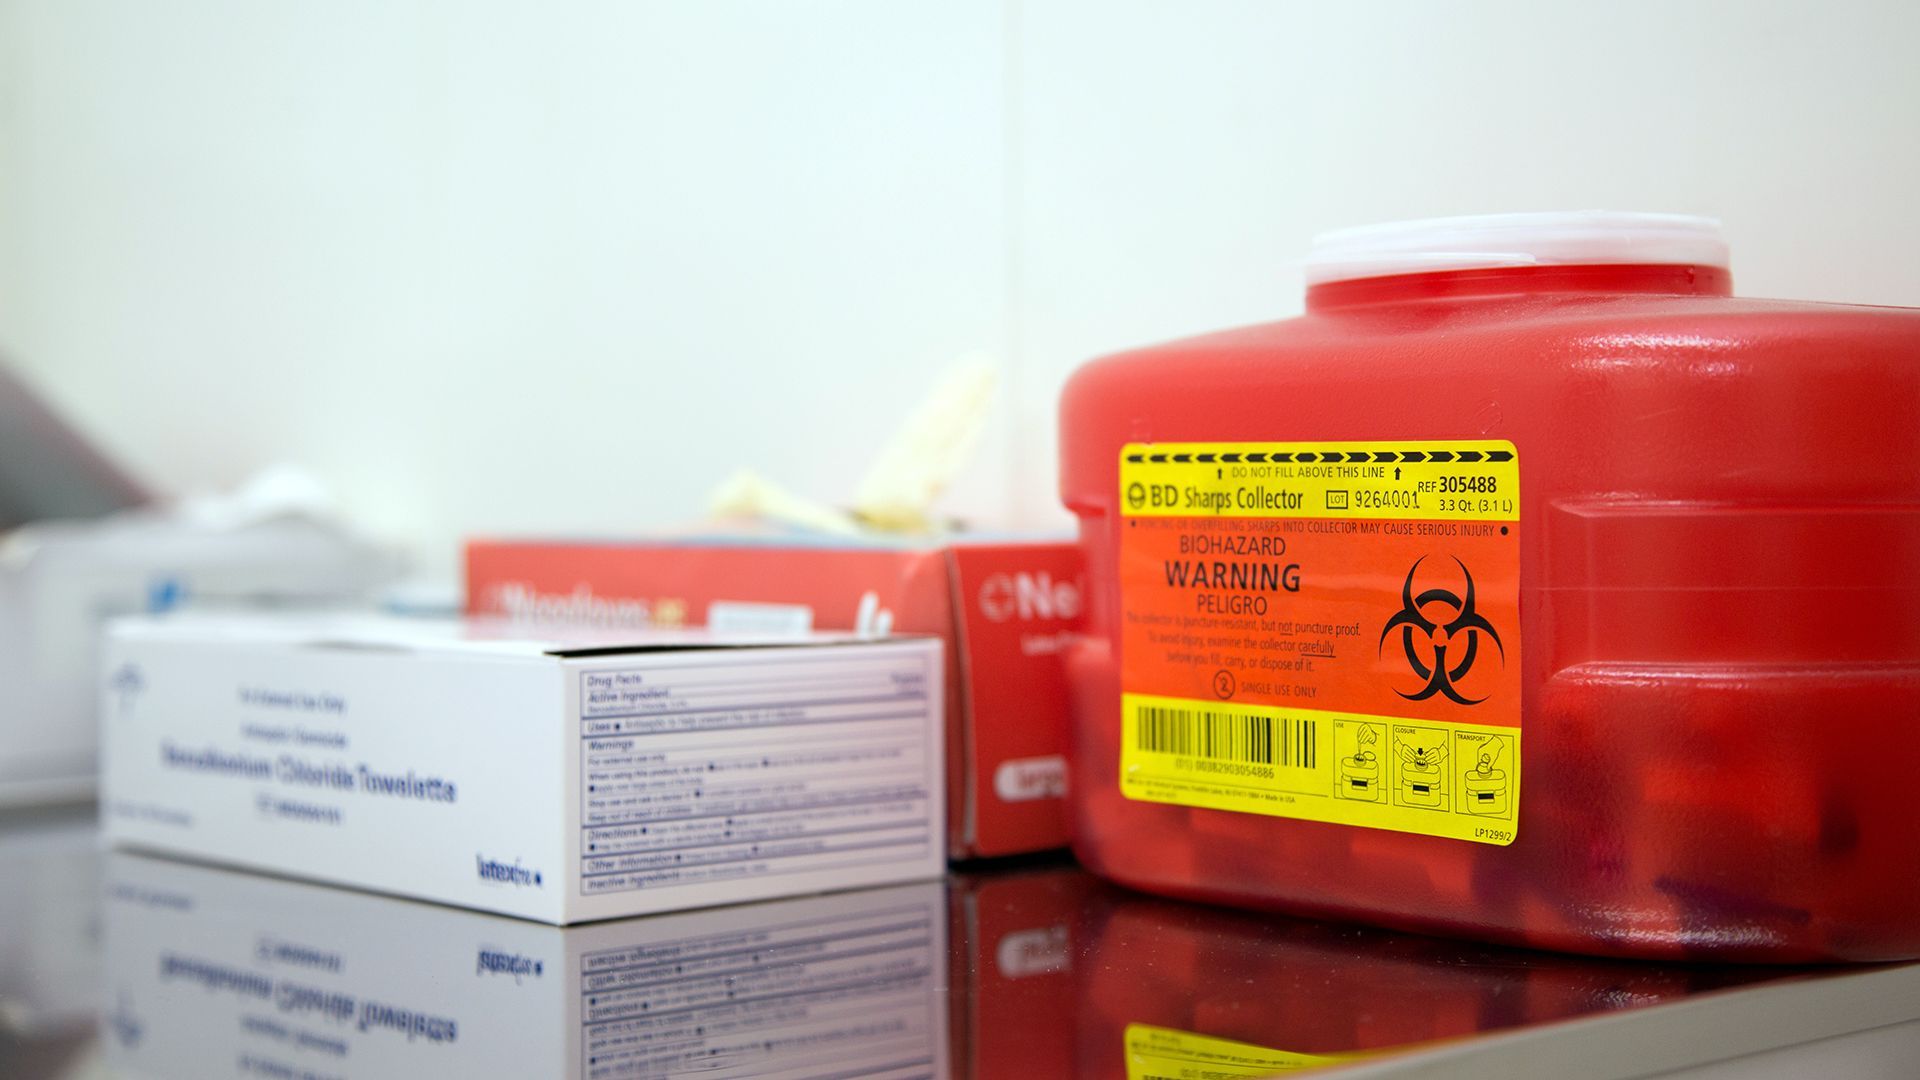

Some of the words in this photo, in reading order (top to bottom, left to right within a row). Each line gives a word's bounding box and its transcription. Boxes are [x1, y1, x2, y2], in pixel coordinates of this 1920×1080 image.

[1232, 466, 1247, 478] DO
[1251, 466, 1271, 478] NOT
[1275, 466, 1294, 478] FILL
[1297, 466, 1333, 478] ABOVE
[1336, 466, 1359, 478] THIS
[1362, 466, 1385, 478] LINE
[1417, 481, 1437, 493] REF
[1438, 476, 1497, 493] 305488
[1150, 484, 1179, 508] BD
[1185, 486, 1232, 514] Sharps
[1236, 486, 1304, 510] Collector
[1330, 495, 1345, 504] LOT
[1354, 490, 1420, 509] 9264001
[1439, 499, 1455, 512] 3.3
[1458, 499, 1475, 512] Qt.
[1478, 499, 1498, 513] (3.1
[1502, 499, 1513, 513] L)
[1247, 520, 1281, 532] SHARPS
[1283, 521, 1305, 532] INTO
[1308, 521, 1358, 534] COLLECTOR
[1360, 522, 1380, 534] MAY
[1383, 523, 1414, 535] CAUSE
[1417, 523, 1457, 536] SERIOUS
[1460, 524, 1495, 537] INJURY
[1179, 535, 1287, 556] BIOHAZARD
[1164, 560, 1301, 592] WARNING
[1197, 594, 1268, 616] PELIGRO
[1261, 619, 1276, 631] but
[1278, 620, 1293, 633] not
[1295, 622, 1333, 635] puncture
[1335, 622, 1361, 638] proof.
[1244, 636, 1258, 649] the
[1260, 637, 1296, 652] collector
[1298, 639, 1335, 657] carefully
[1249, 658, 1258, 668] or
[1260, 657, 1293, 673] dispose
[1294, 658, 1304, 672] of
[1306, 659, 1315, 673] it.
[586, 675, 612, 688] Drug
[615, 674, 642, 685] Facts
[588, 691, 618, 703] Active
[1241, 681, 1271, 696] SINGLE
[1275, 683, 1291, 697] USE
[1294, 684, 1317, 698] ONLY
[1394, 727, 1416, 735] CLOSURE
[1457, 733, 1486, 742] TRANSPORT
[588, 740, 635, 753] Warnings
[587, 828, 639, 841] Directions
[1474, 827, 1512, 842] LP1299/2
